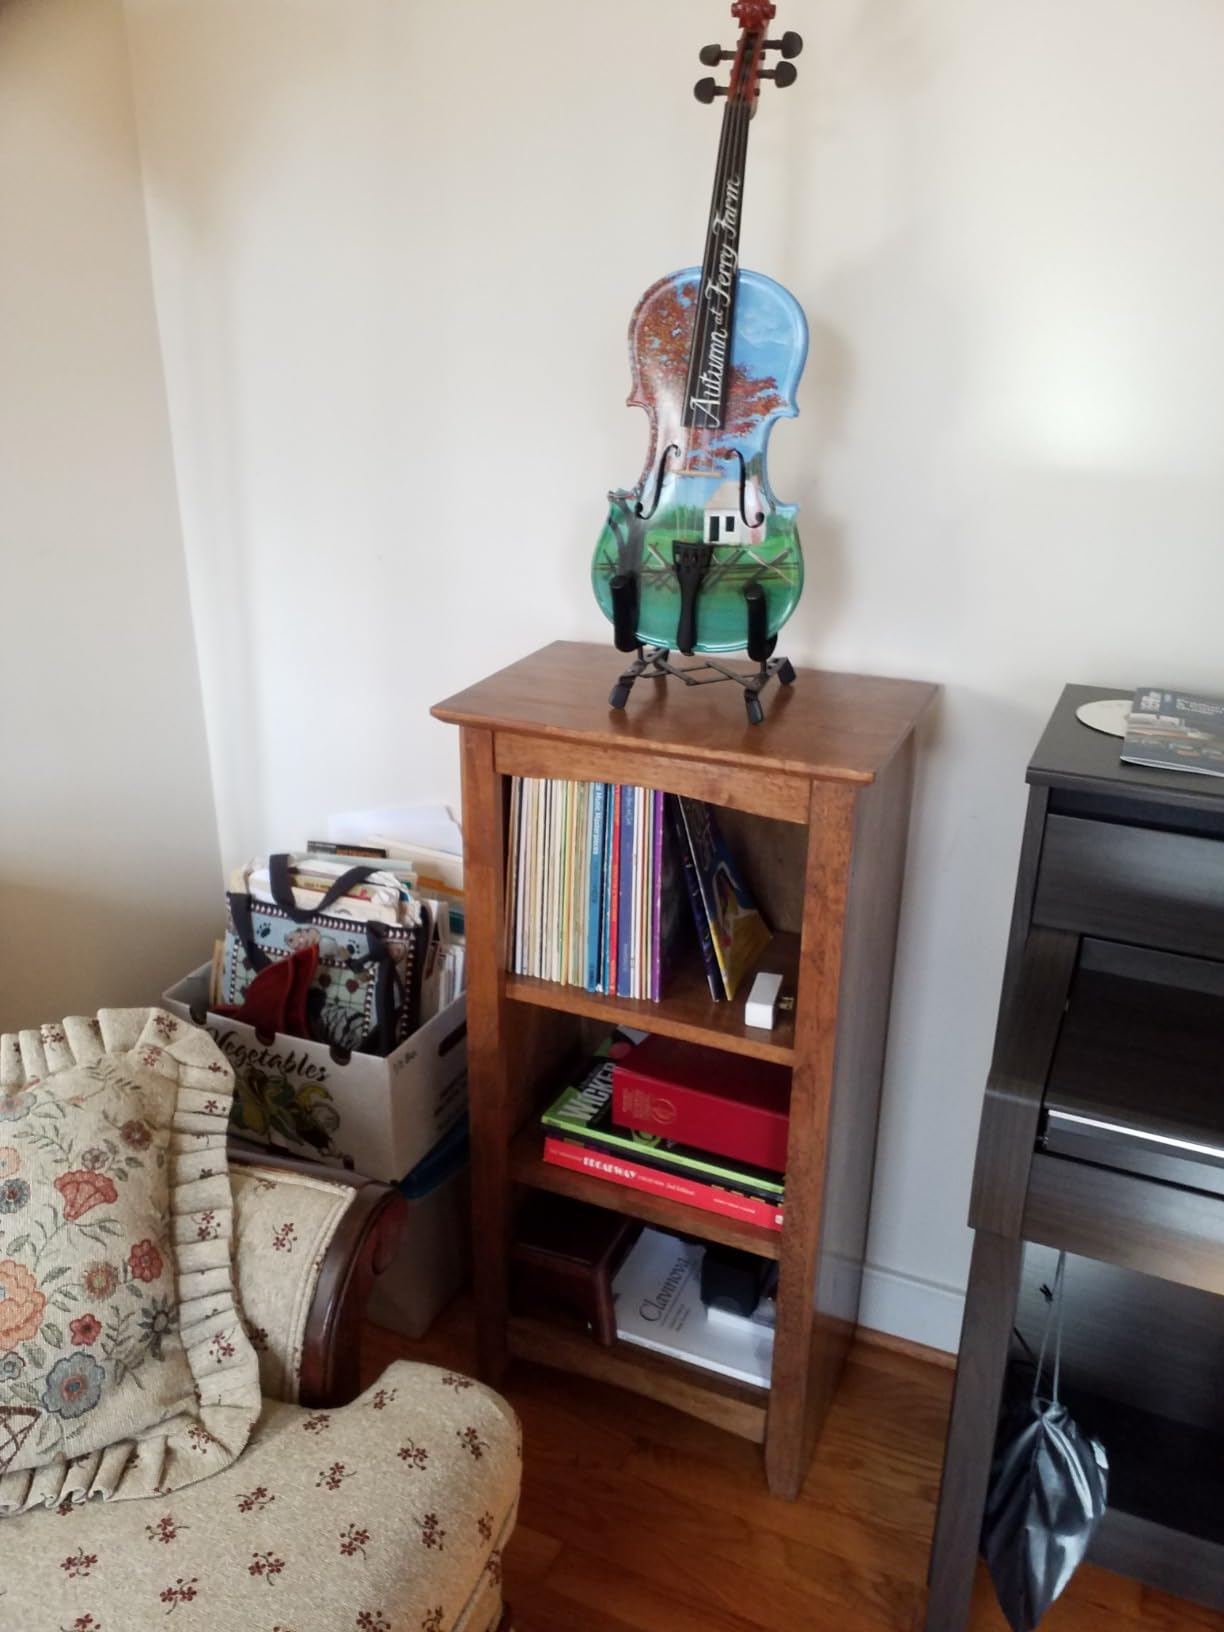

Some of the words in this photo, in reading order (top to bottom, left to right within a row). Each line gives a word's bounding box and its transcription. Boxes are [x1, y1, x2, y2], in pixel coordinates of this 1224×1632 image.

[712, 175, 741, 239] Farm
[705, 243, 739, 307] Ferry
[708, 307, 724, 325] at
[690, 328, 728, 428] Autumn
[205, 1027, 331, 1082] Vegetables
[639, 1257, 691, 1322] Clavinova
